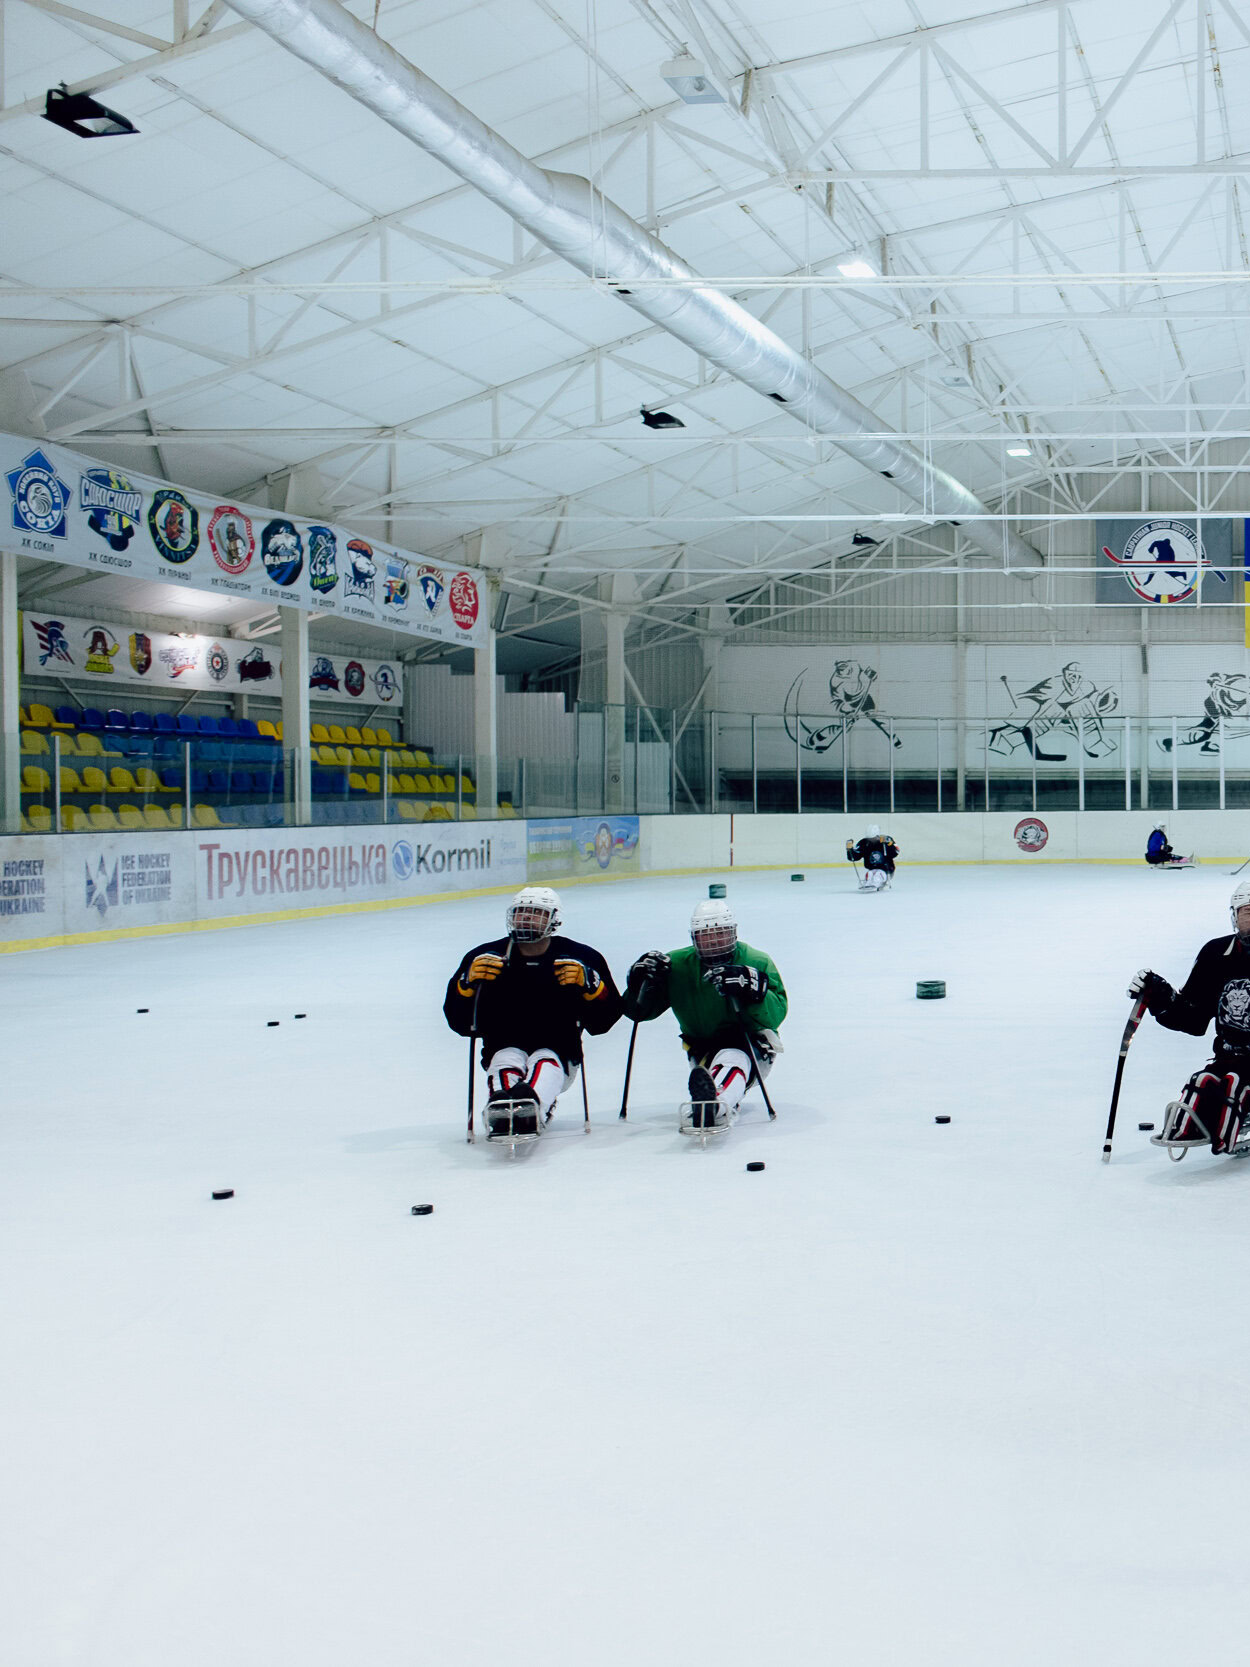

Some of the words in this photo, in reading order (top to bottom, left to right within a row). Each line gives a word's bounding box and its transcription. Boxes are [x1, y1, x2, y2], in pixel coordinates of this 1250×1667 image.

[81, 478, 142, 517] СДЮСШОР
[19, 500, 61, 529] СОКІЛ
[21, 538, 31, 548] ХК
[33, 540, 55, 552] СОКІЛ
[1125, 526, 1151, 557] CARPATHIAN
[1171, 522, 1193, 538] HOCKEY
[88, 552, 97, 561] ХК
[100, 554, 132, 568] СДЮСШОР
[454, 612, 475, 625] СПАРТА
[121, 855, 136, 870] ICE
[138, 853, 171, 869] HOCKEY
[416, 839, 492, 874] Kormil
[4, 859, 44, 877] HOCKEY
[199, 843, 387, 901] Трускавецька
[0, 878, 45, 896] ERATION
[122, 870, 171, 888] FEDERATION
[122, 890, 134, 905] OF
[135, 886, 172, 904] UKRAINE
